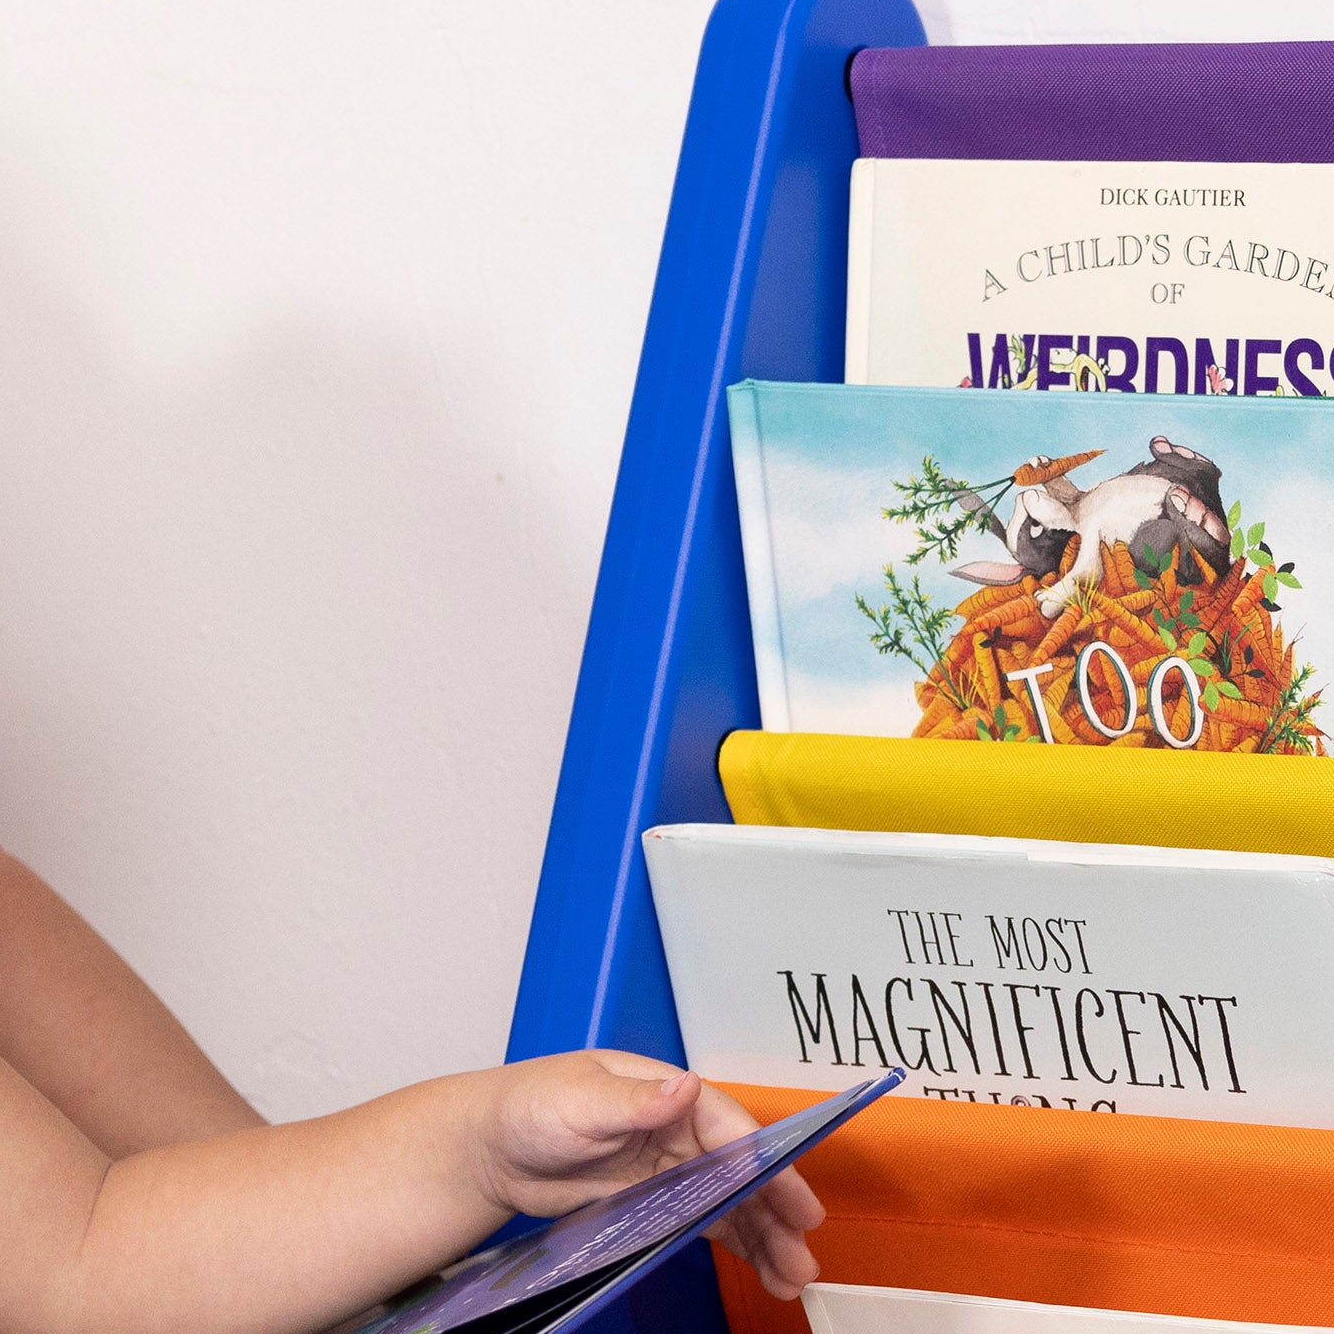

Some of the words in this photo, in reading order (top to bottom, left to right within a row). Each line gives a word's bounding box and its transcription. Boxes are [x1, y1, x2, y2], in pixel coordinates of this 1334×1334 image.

[1100, 188, 1149, 207] DICK
[1154, 188, 1246, 207] GAUTIER
[979, 268, 1008, 303] A
[1015, 233, 1171, 284] CHILD'S
[1149, 283, 1186, 305] OF
[1007, 641, 1205, 748] TOO
[887, 909, 974, 969] THE
[985, 914, 1094, 975] MOST
[776, 970, 1248, 1094] MAGNIFICENT
